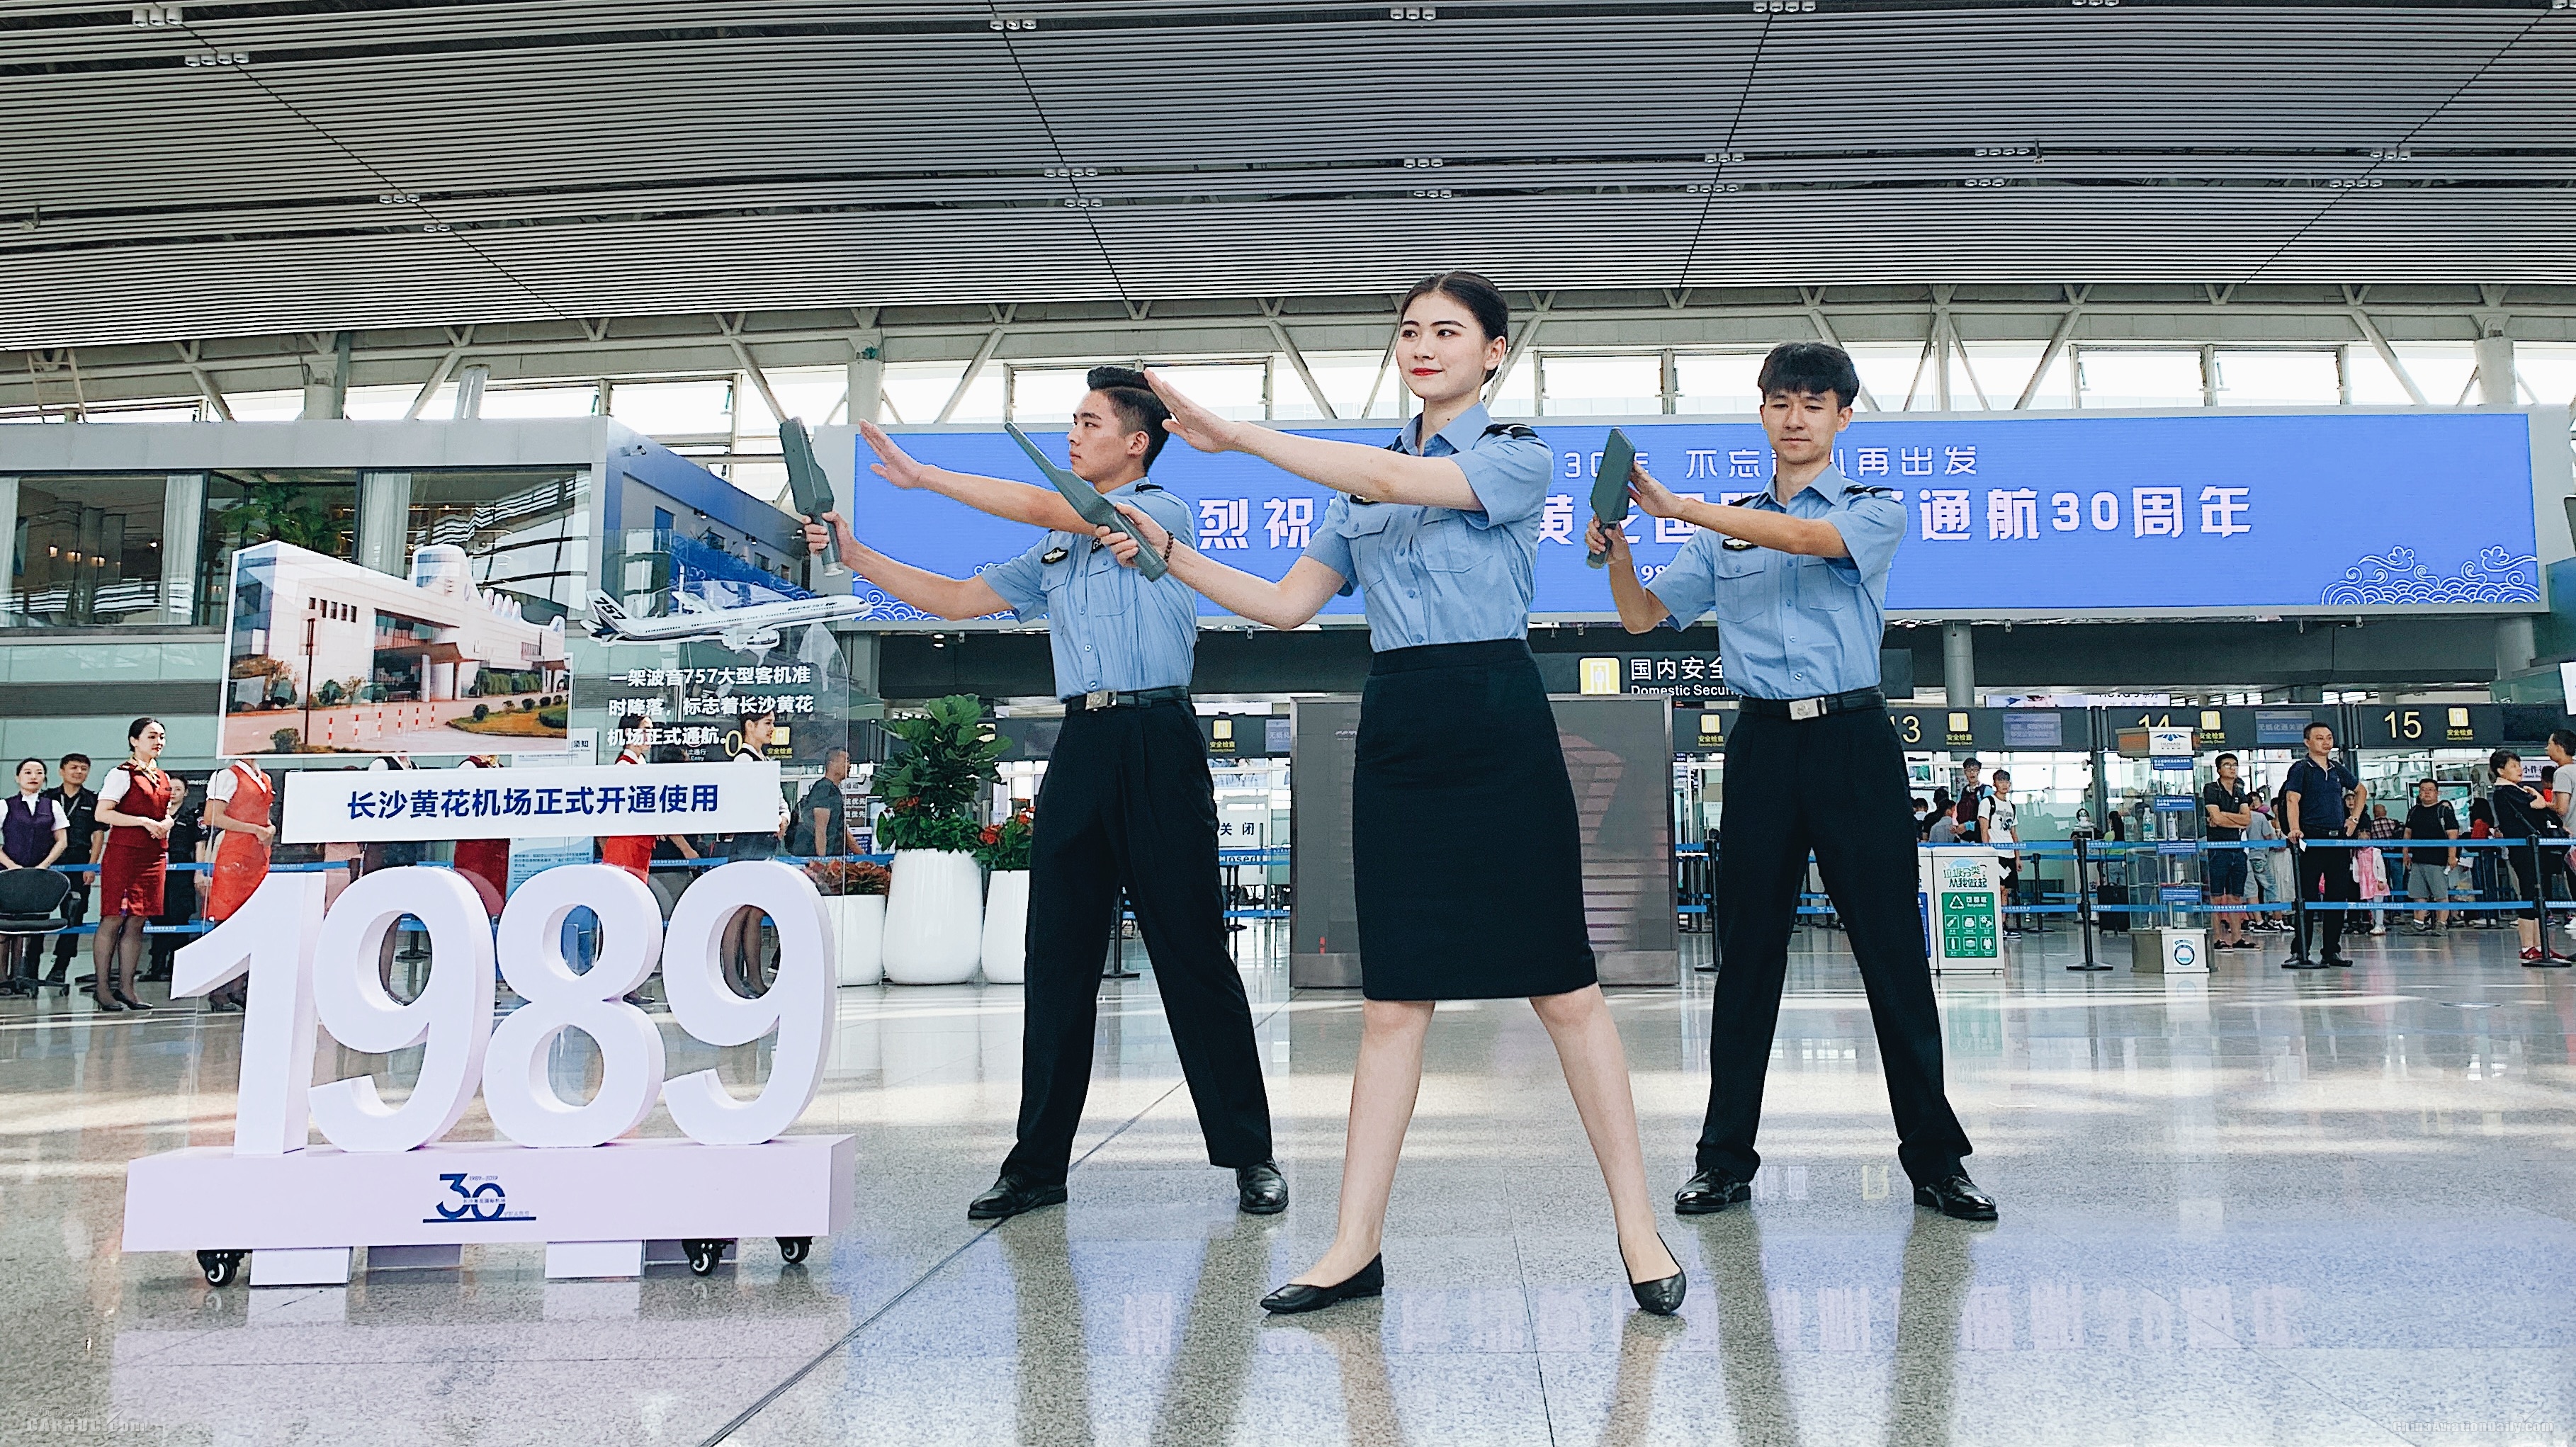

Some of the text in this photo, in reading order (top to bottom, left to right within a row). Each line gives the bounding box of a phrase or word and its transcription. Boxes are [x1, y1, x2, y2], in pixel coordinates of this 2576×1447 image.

[594, 597, 627, 619] 757
[609, 666, 810, 687] 一架波音757大型客机准
[1631, 684, 1690, 696] Domestic
[609, 695, 813, 716] 时降落，标志着长沙黄花
[1889, 715, 1921, 743] 3
[2384, 710, 2422, 739] 15
[607, 726, 726, 746] 机场正式通航。
[347, 785, 719, 820] 长沙黄花机场正式开通使用
[1220, 822, 1255, 836] 关闭
[170, 859, 837, 1156] 1989
[436, 1173, 506, 1219] 30
